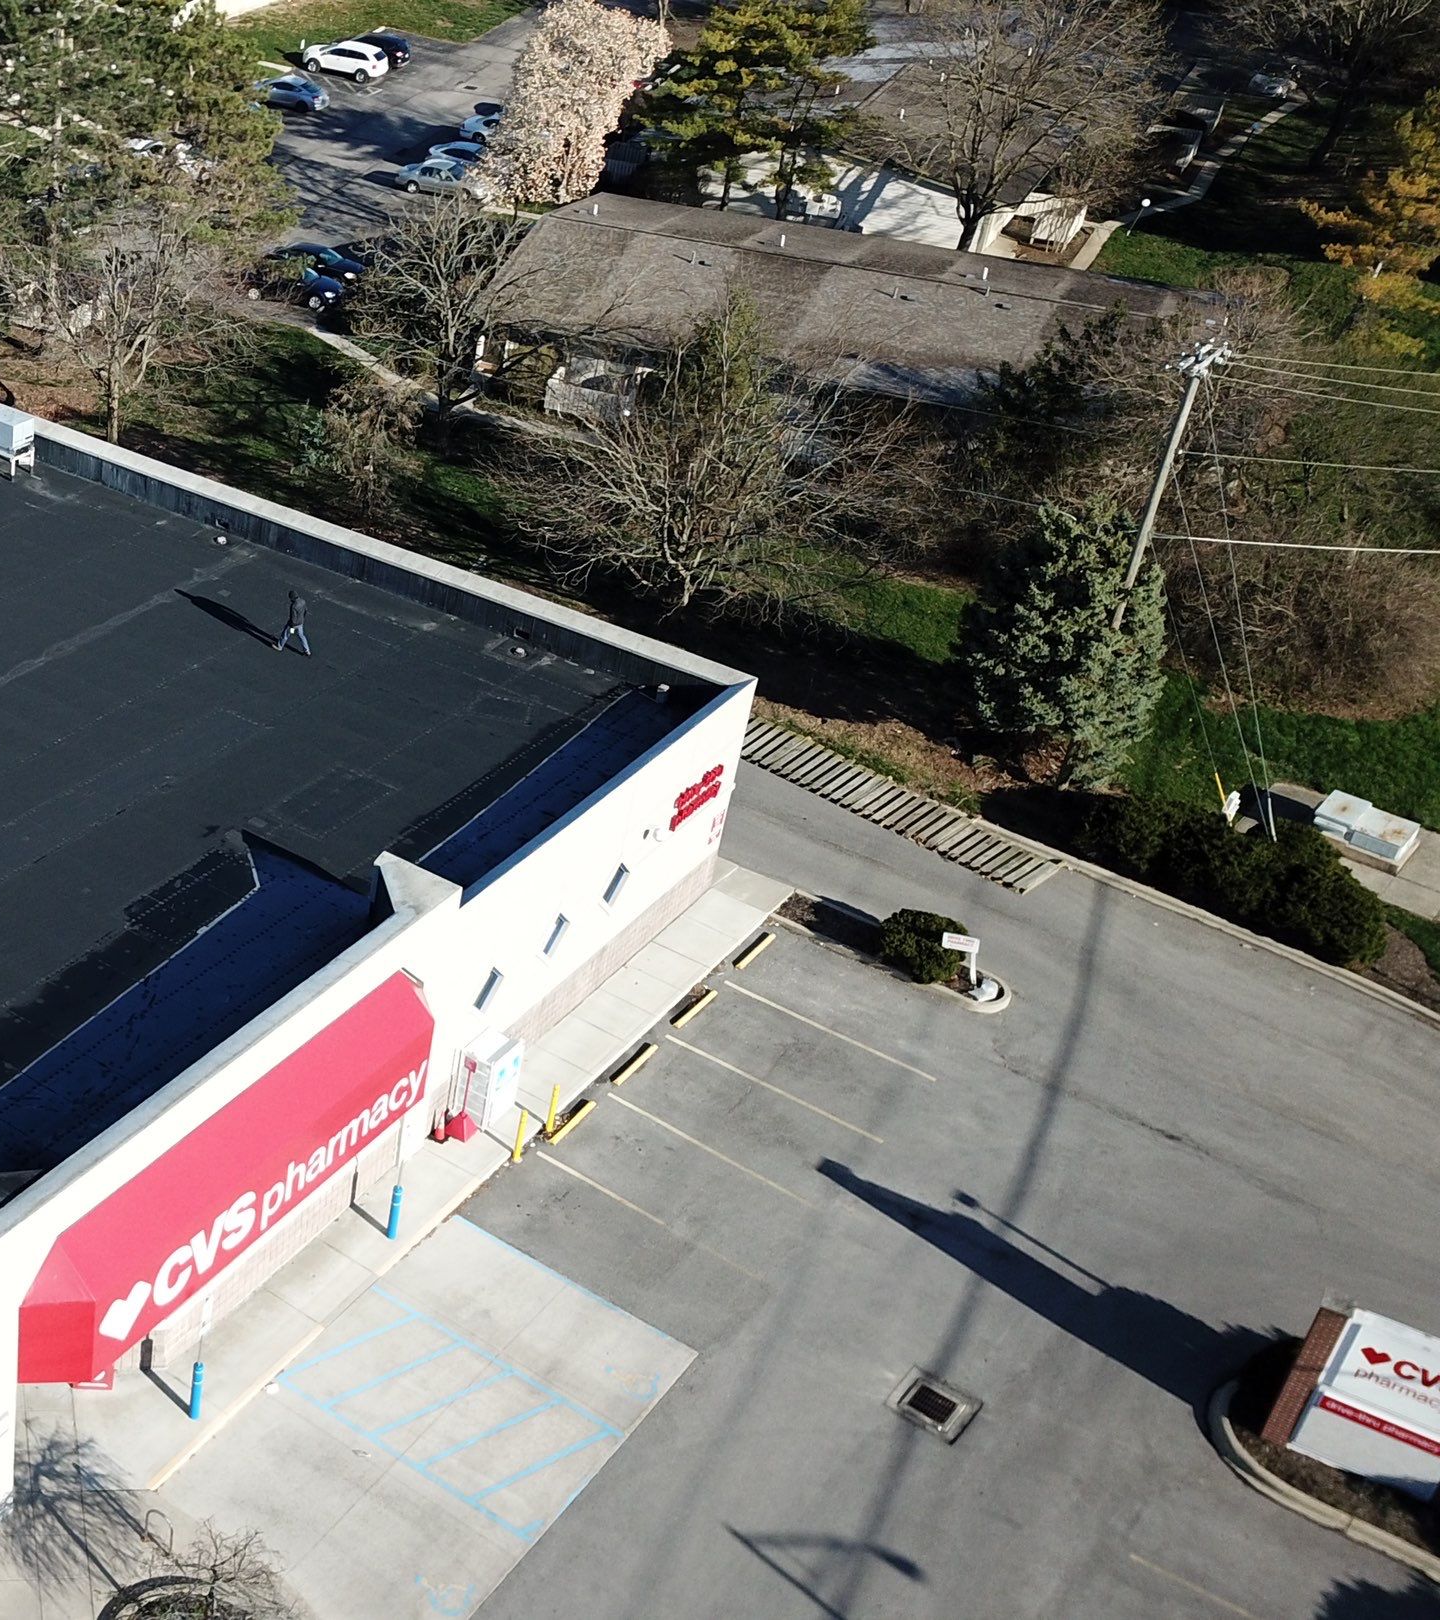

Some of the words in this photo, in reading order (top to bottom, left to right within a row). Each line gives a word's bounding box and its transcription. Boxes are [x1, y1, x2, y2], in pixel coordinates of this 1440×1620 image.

[153, 1190, 256, 1306] CVS
[259, 1058, 428, 1232] pharmacy
[1353, 1367, 1440, 1413] pharmac
[1393, 1360, 1440, 1392] CV
